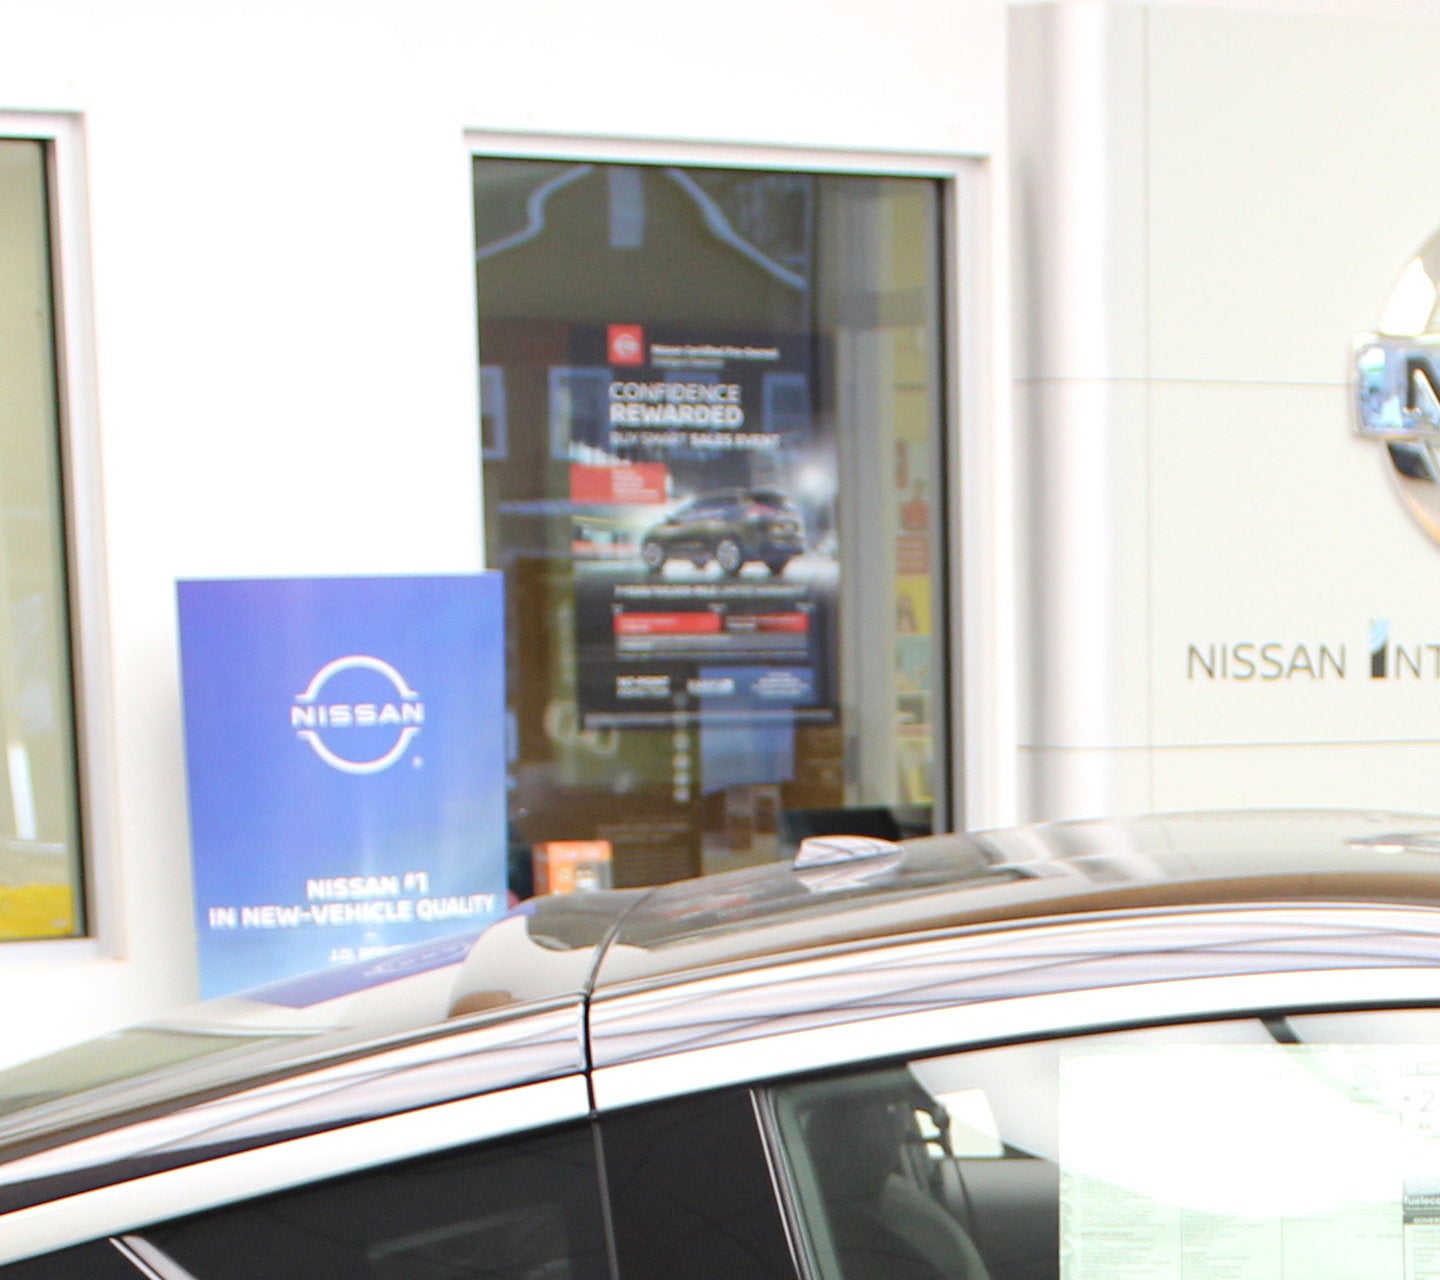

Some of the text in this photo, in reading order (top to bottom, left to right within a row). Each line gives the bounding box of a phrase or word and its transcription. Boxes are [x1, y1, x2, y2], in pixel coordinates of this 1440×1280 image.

[608, 382, 742, 404] CONFIDENCE
[610, 402, 745, 429] REWARDED
[1186, 642, 1348, 680] NISSAN
[291, 702, 425, 728] NISSAN
[306, 871, 430, 900] NISSAN #1
[208, 893, 497, 930] IN NEW-VEHICLE QUALITY
